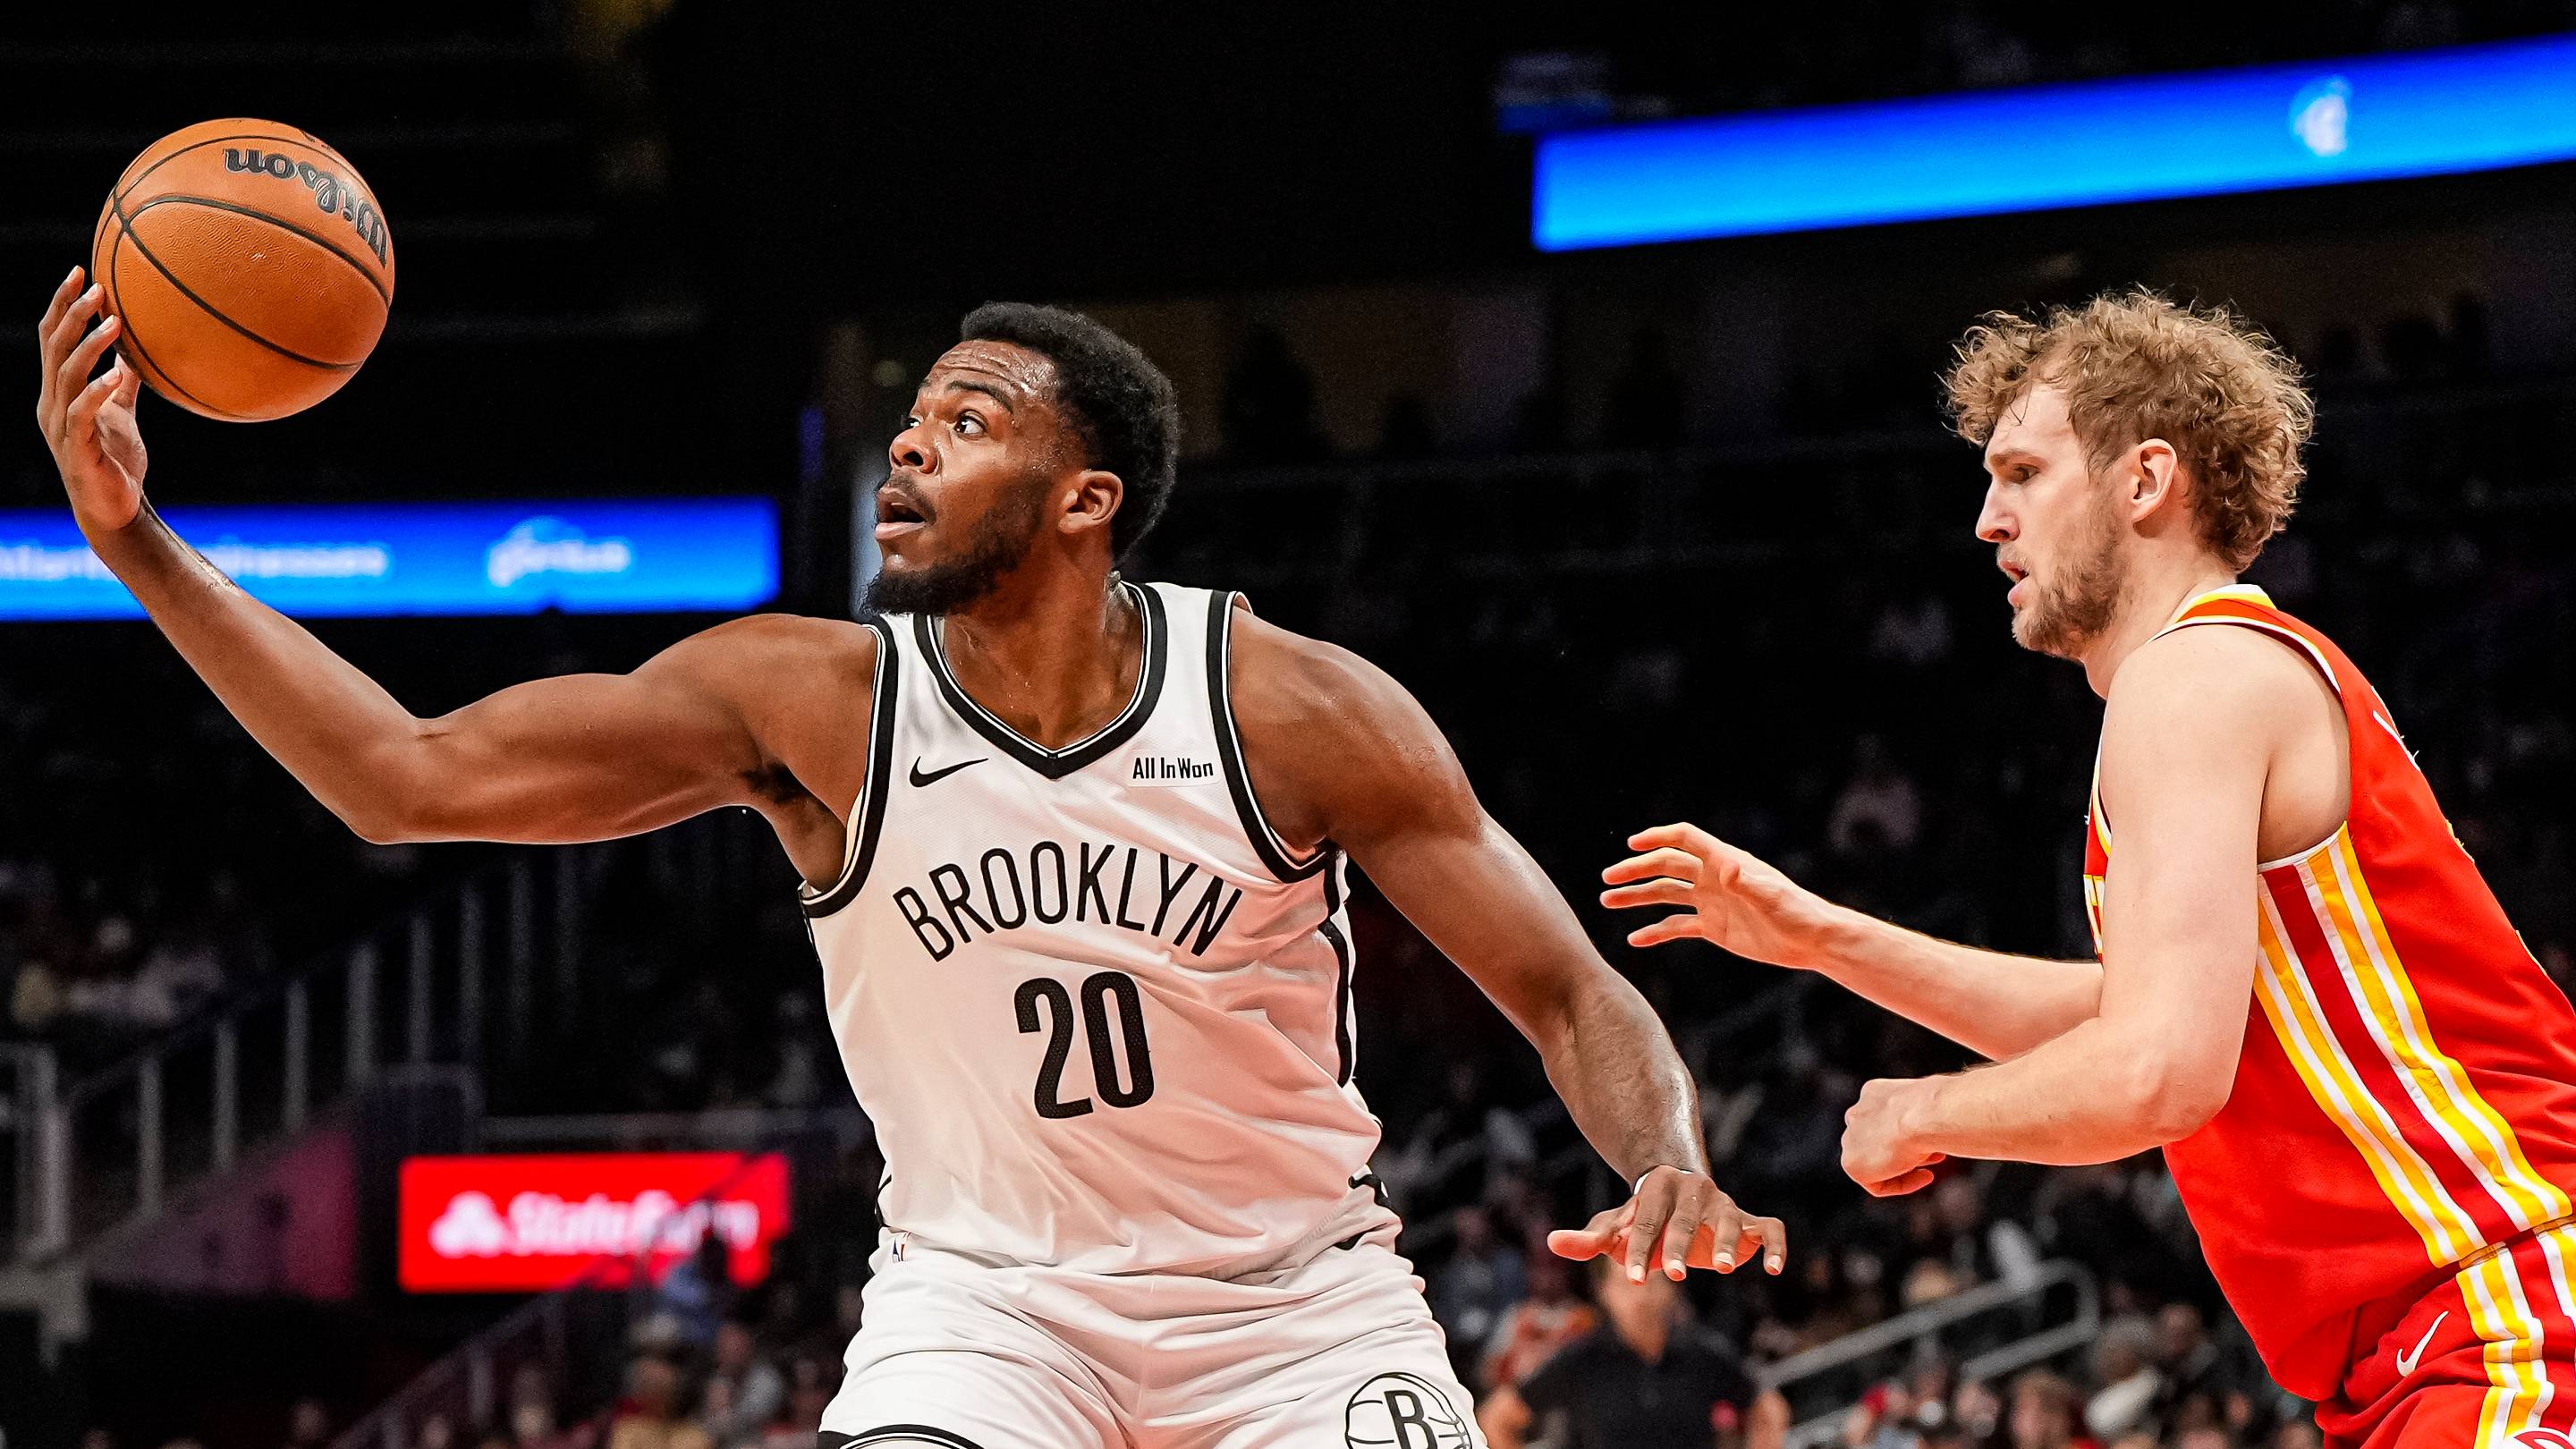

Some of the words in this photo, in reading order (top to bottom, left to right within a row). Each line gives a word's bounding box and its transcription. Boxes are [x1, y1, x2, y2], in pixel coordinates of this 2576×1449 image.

[224, 147, 388, 270] Wilson
[1132, 757, 1155, 779] All
[1160, 757, 1176, 779] In
[1177, 757, 1214, 779] Won
[893, 841, 1243, 962] BROOKLYN
[1013, 971, 1155, 1119] 20
[1384, 1390, 1438, 1449] B
